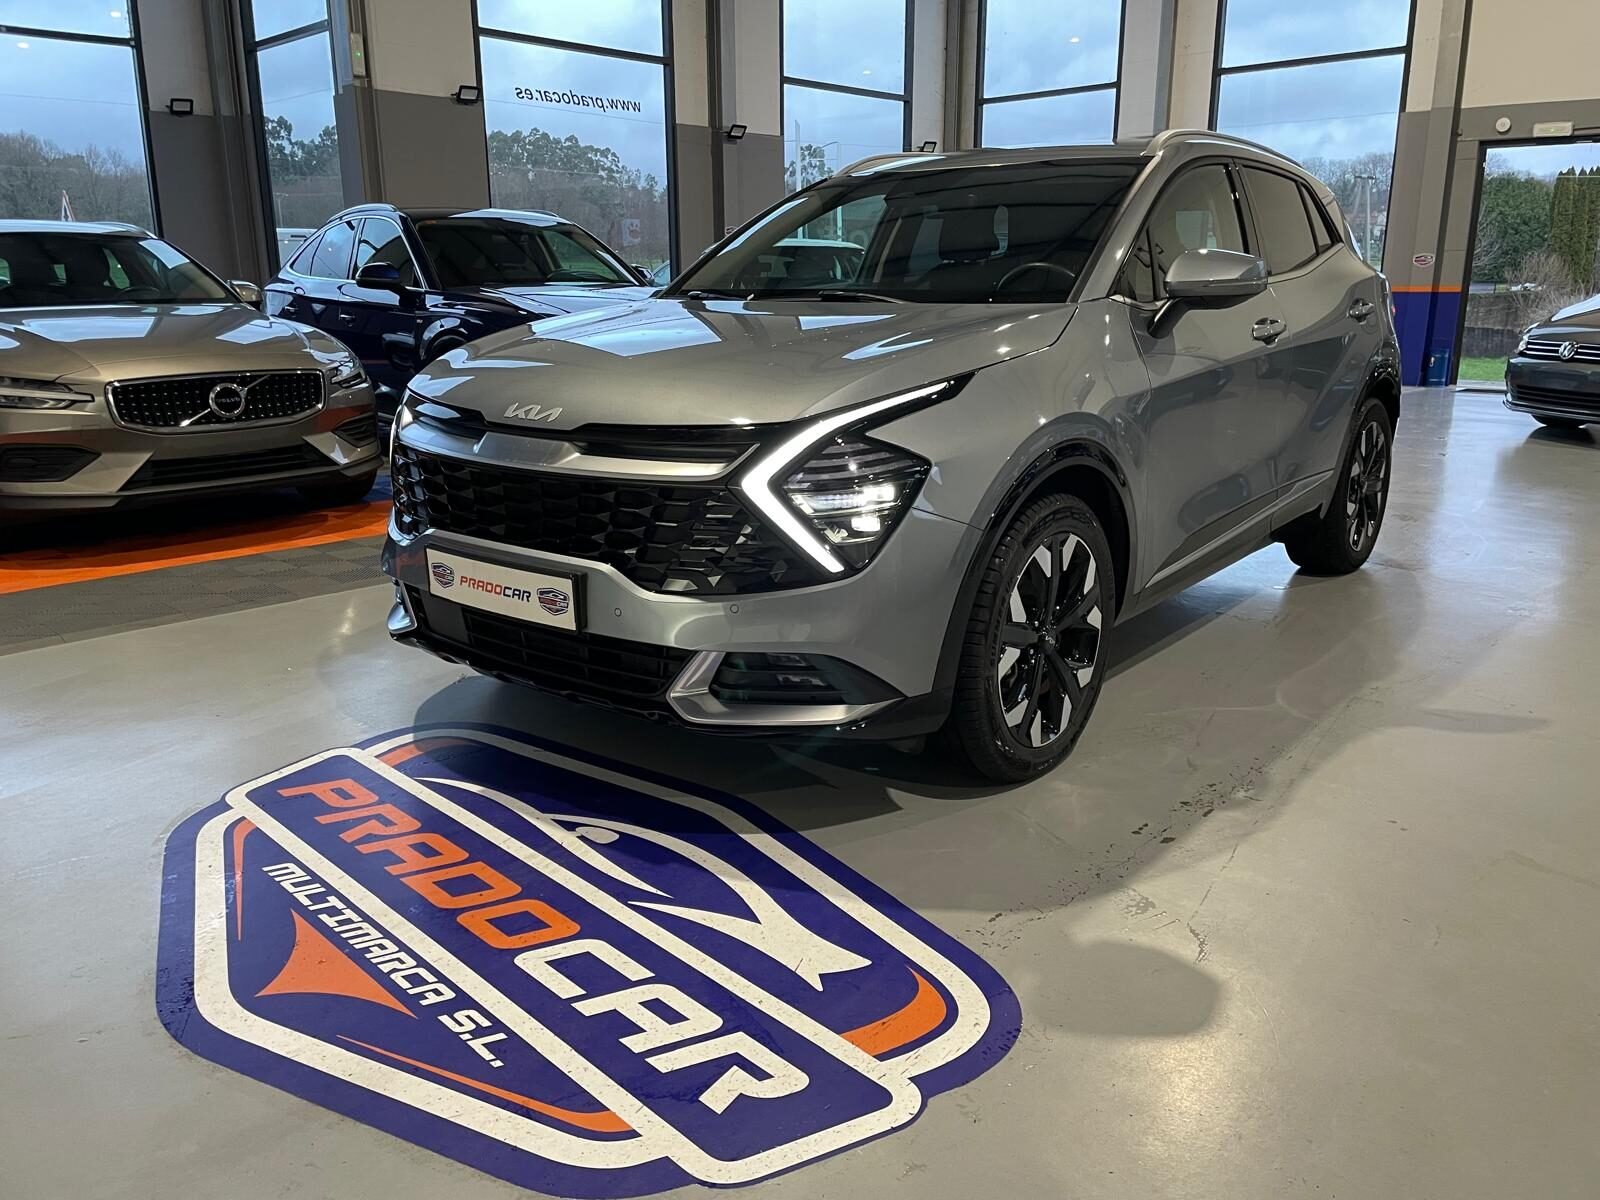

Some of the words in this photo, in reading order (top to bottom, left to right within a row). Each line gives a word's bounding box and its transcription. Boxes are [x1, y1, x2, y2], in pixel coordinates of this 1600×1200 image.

[503, 402, 563, 422] KIA
[459, 575, 532, 603] PRADOCAR
[261, 862, 457, 1006] MULTIMARCA
[437, 1009, 510, 1069] S.L.
[276, 778, 810, 1115] PRADOCAR
